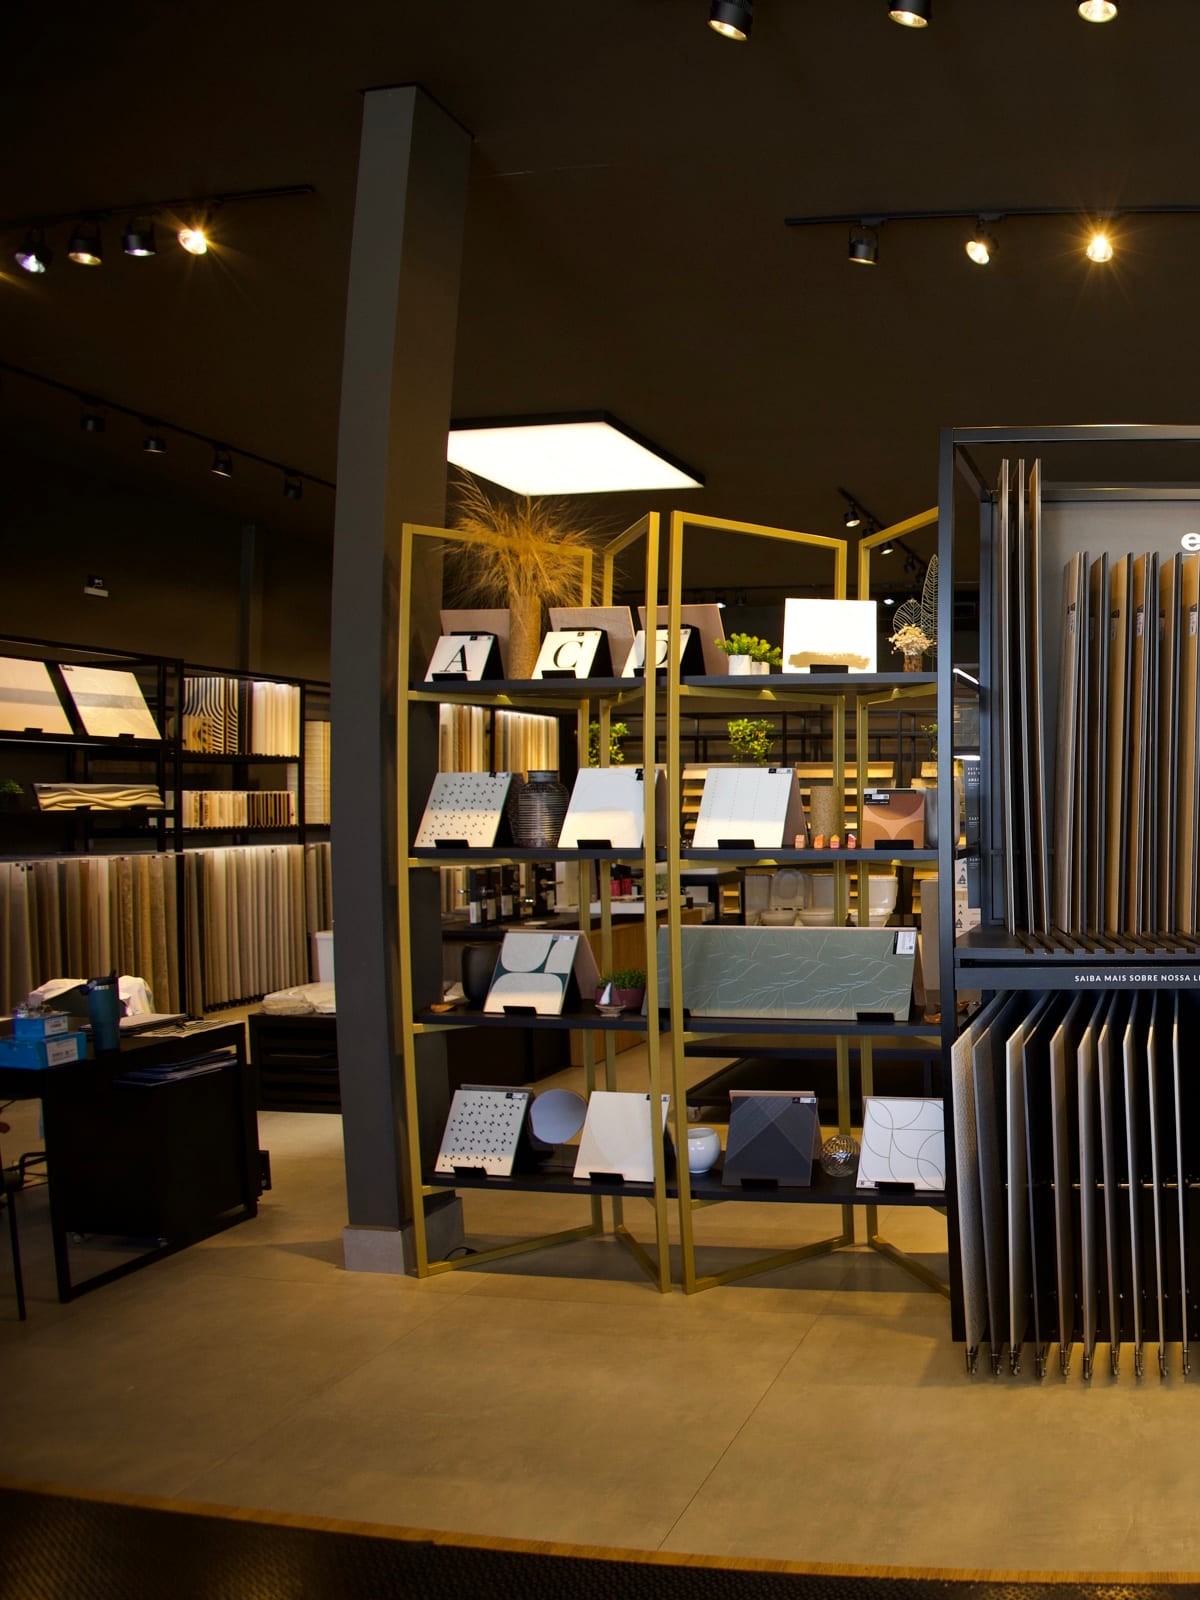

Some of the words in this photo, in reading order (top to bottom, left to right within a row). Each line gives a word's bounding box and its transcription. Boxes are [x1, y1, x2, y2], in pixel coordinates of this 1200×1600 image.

[440, 644, 471, 672] A
[553, 640, 584, 668] C
[1129, 974, 1158, 982] SOBRE
[1160, 974, 1191, 982] NOSSA
